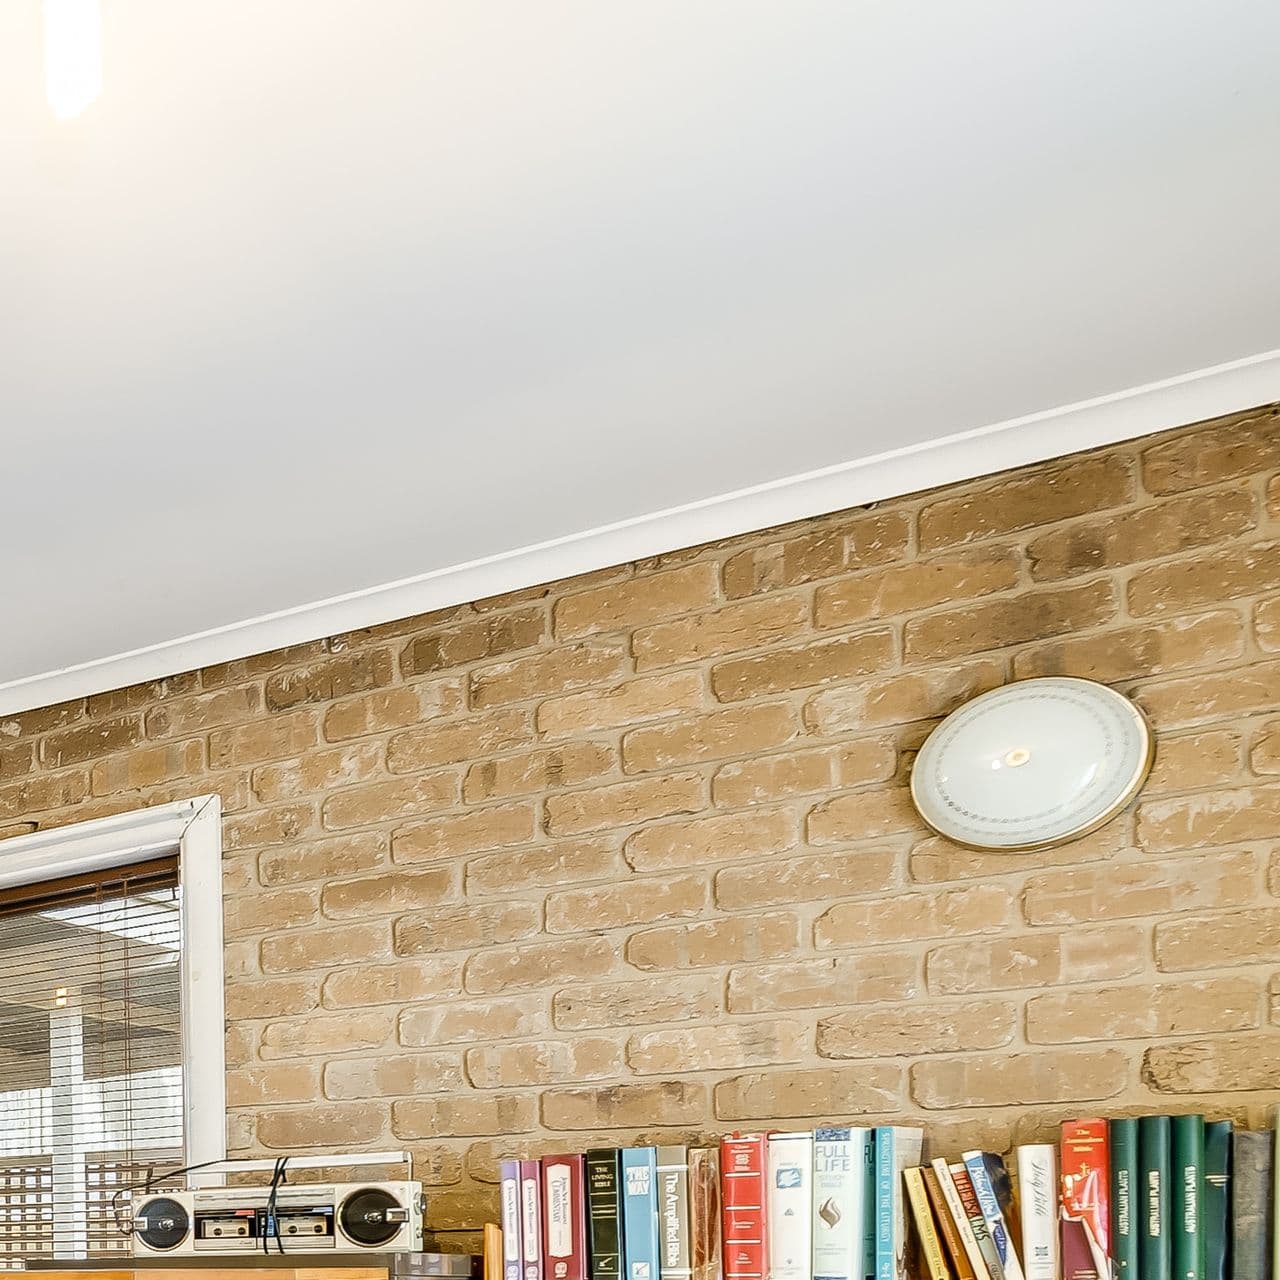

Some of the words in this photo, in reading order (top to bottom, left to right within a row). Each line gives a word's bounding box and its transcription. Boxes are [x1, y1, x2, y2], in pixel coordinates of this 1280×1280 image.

[815, 1145, 850, 1158] FULL
[628, 1167, 650, 1181] THE
[815, 1158, 850, 1172] LIFE
[628, 1181, 650, 1195] WAY
[666, 1172, 679, 1192] The
[1117, 1170, 1129, 1195] PLANTS
[1148, 1171, 1160, 1196] PLANTS
[1184, 1166, 1196, 1191] PLANTS
[664, 1192, 680, 1241] Amplified
[1117, 1196, 1129, 1235] AUSTRALIAN
[1148, 1197, 1160, 1237] AUSTRALIAN
[1184, 1192, 1196, 1233] AUSTRALIAN
[667, 1242, 680, 1267] Bible
